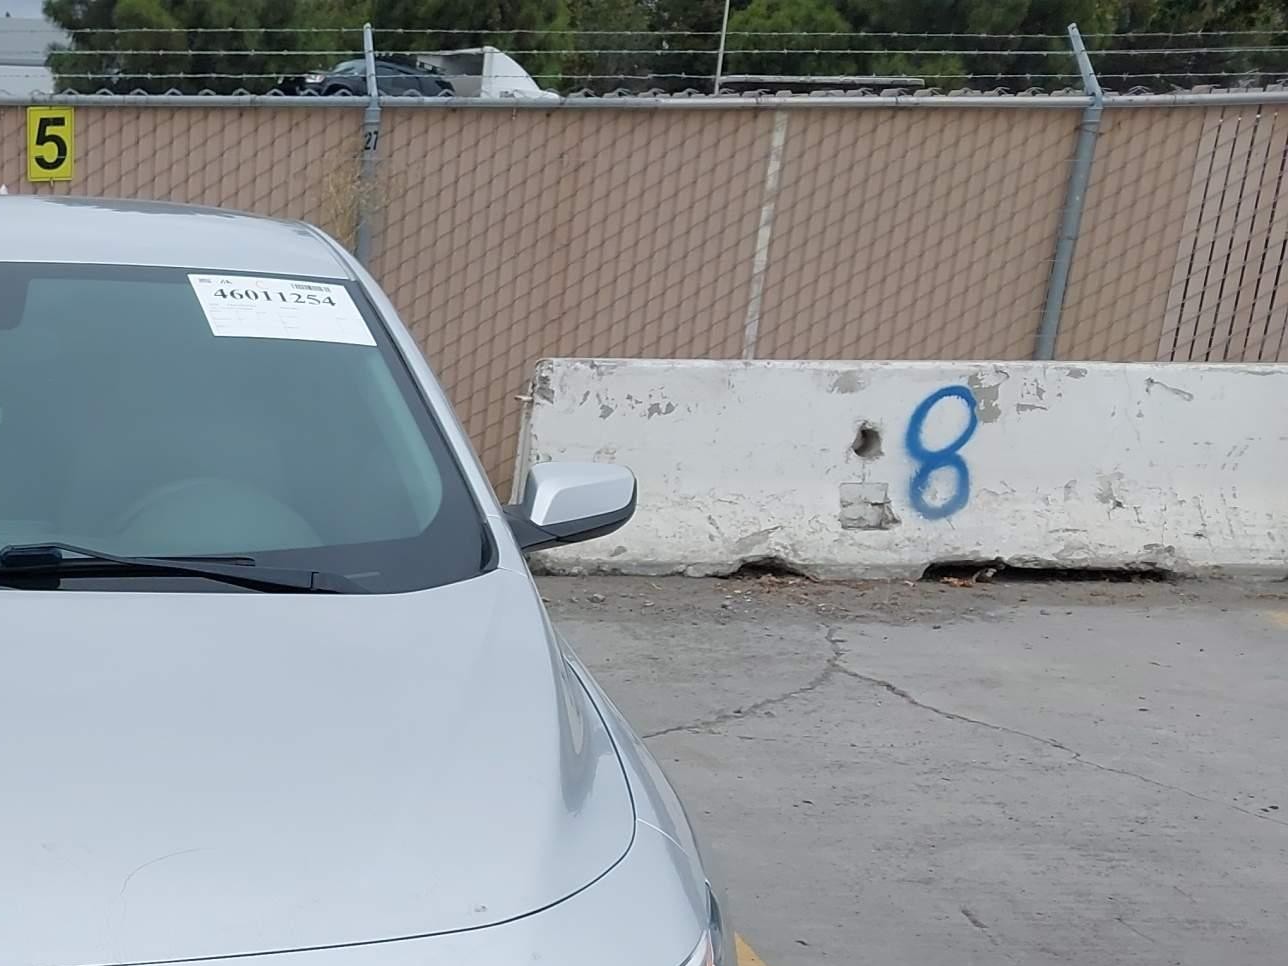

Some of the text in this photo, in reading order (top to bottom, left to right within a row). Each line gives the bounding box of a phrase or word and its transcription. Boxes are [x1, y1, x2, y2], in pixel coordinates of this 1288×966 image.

[35, 117, 67, 170] 5
[364, 130, 379, 150] 27
[214, 288, 336, 307] 46011254
[906, 385, 978, 520] 8
